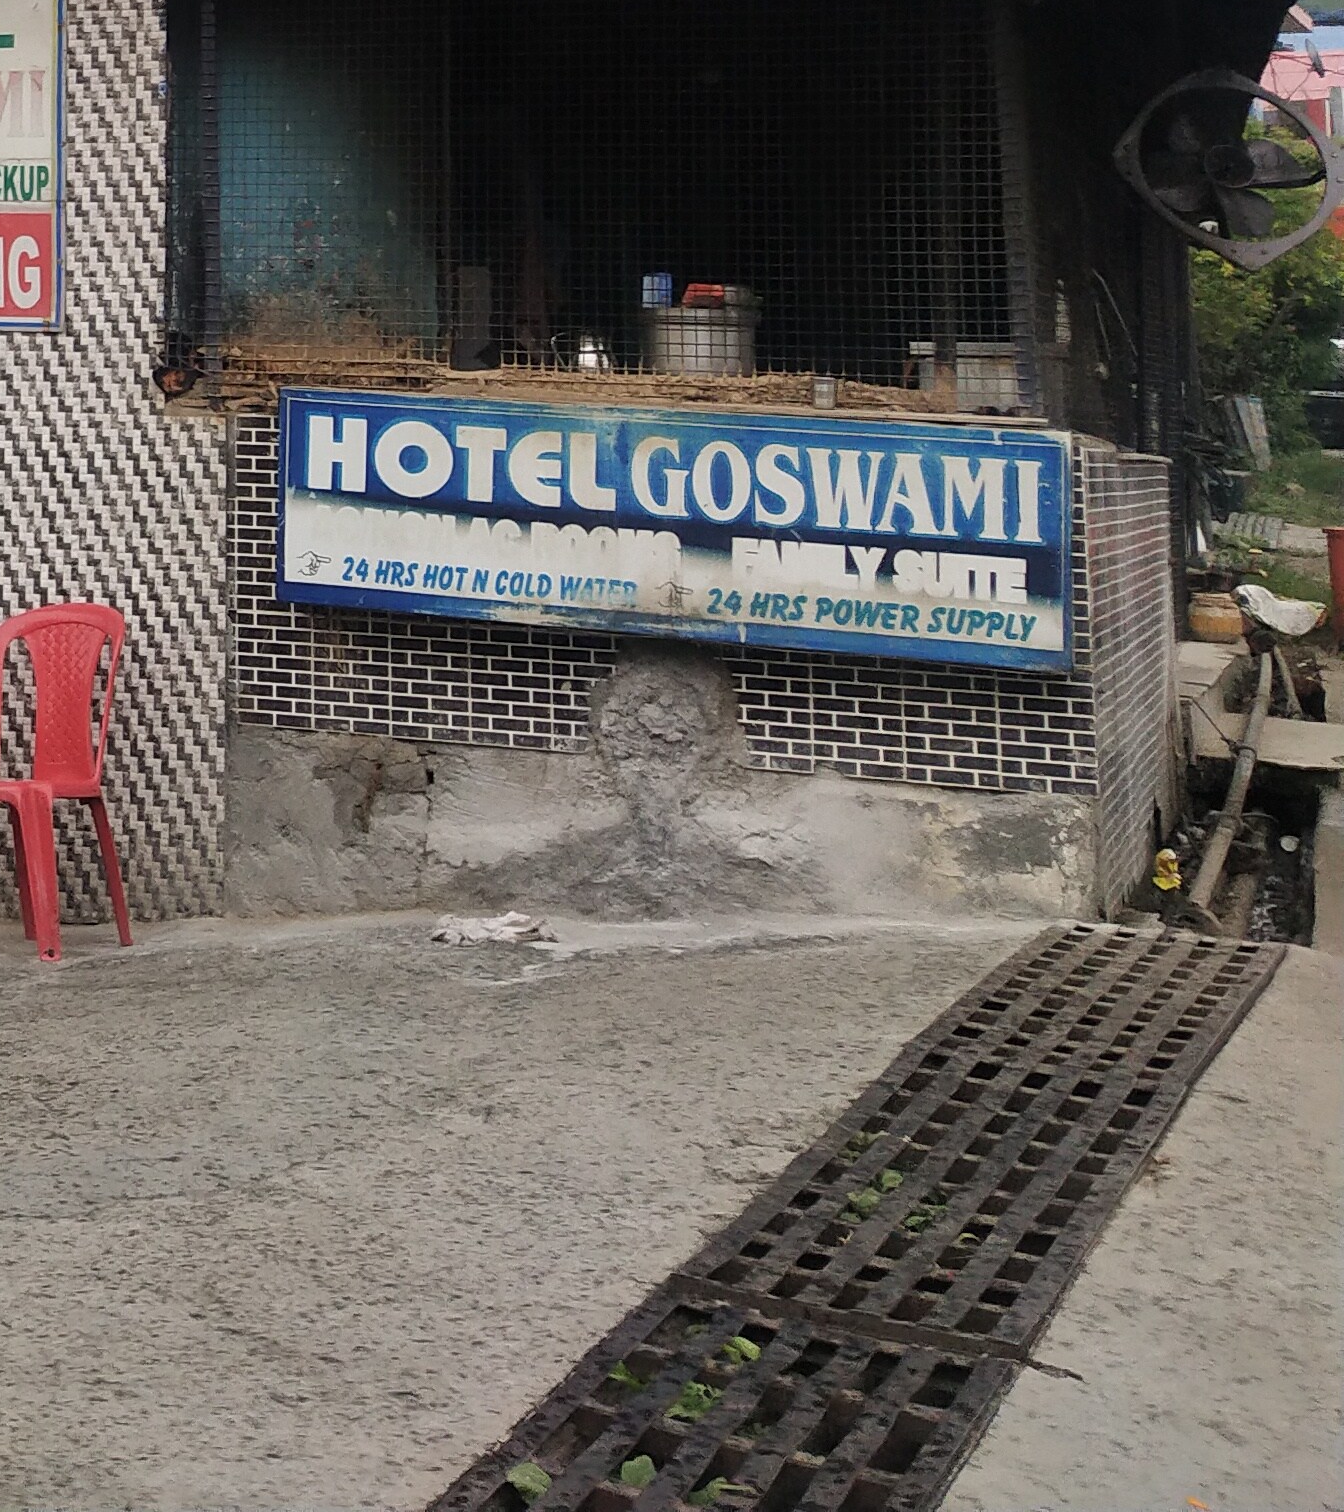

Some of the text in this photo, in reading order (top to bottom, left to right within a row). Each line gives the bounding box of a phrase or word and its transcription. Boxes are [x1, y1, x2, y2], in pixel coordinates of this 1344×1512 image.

[307, 414, 617, 512] HOTEL
[631, 436, 1044, 545] GOSWAMI
[342, 556, 640, 605] 24 HRS HOT N COLD WATER
[706, 587, 1038, 643] 24 HRS POWER SUPPLY
